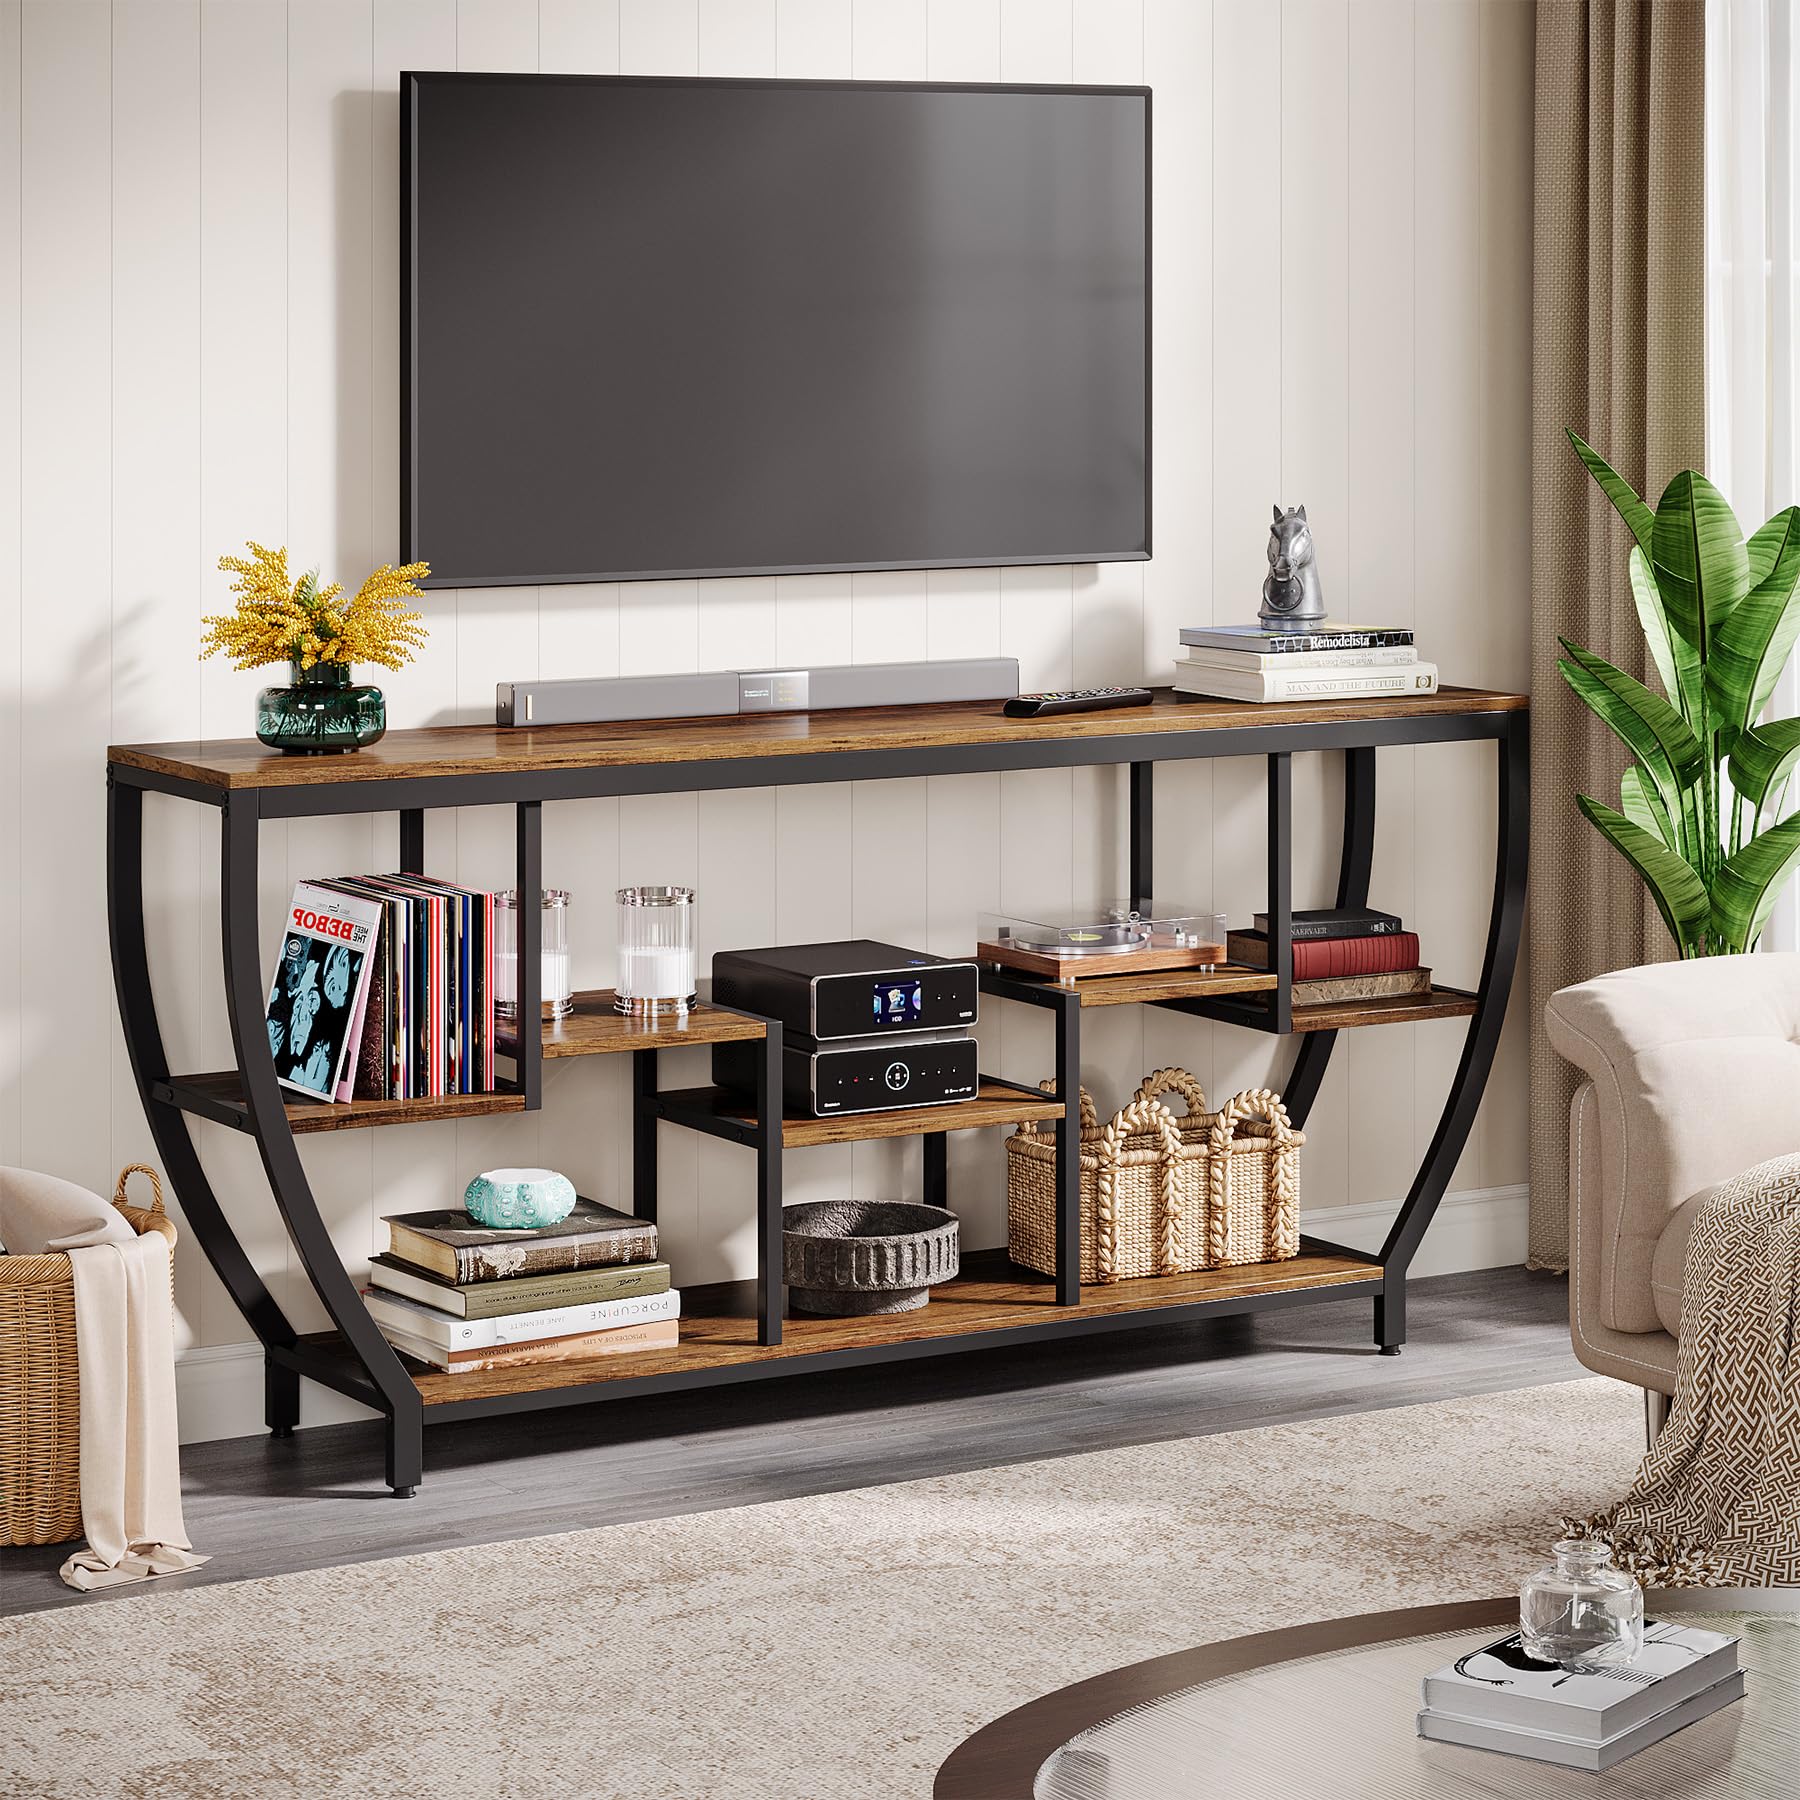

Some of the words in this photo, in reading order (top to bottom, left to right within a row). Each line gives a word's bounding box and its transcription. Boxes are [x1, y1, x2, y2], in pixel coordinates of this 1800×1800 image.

[1310, 634, 1370, 650] Remodelista
[1286, 684, 1312, 694] MAN
[1313, 682, 1337, 692] AND
[1338, 681, 1361, 691] THE
[1365, 678, 1406, 690] FUTURE
[509, 1319, 545, 1330] BENNETT
[546, 1316, 566, 1325] JANE
[582, 1337, 597, 1346] LIFE
[613, 1332, 647, 1342] EPISODES
[478, 1348, 510, 1357] HOLMAN
[511, 1344, 535, 1353] MARIA
